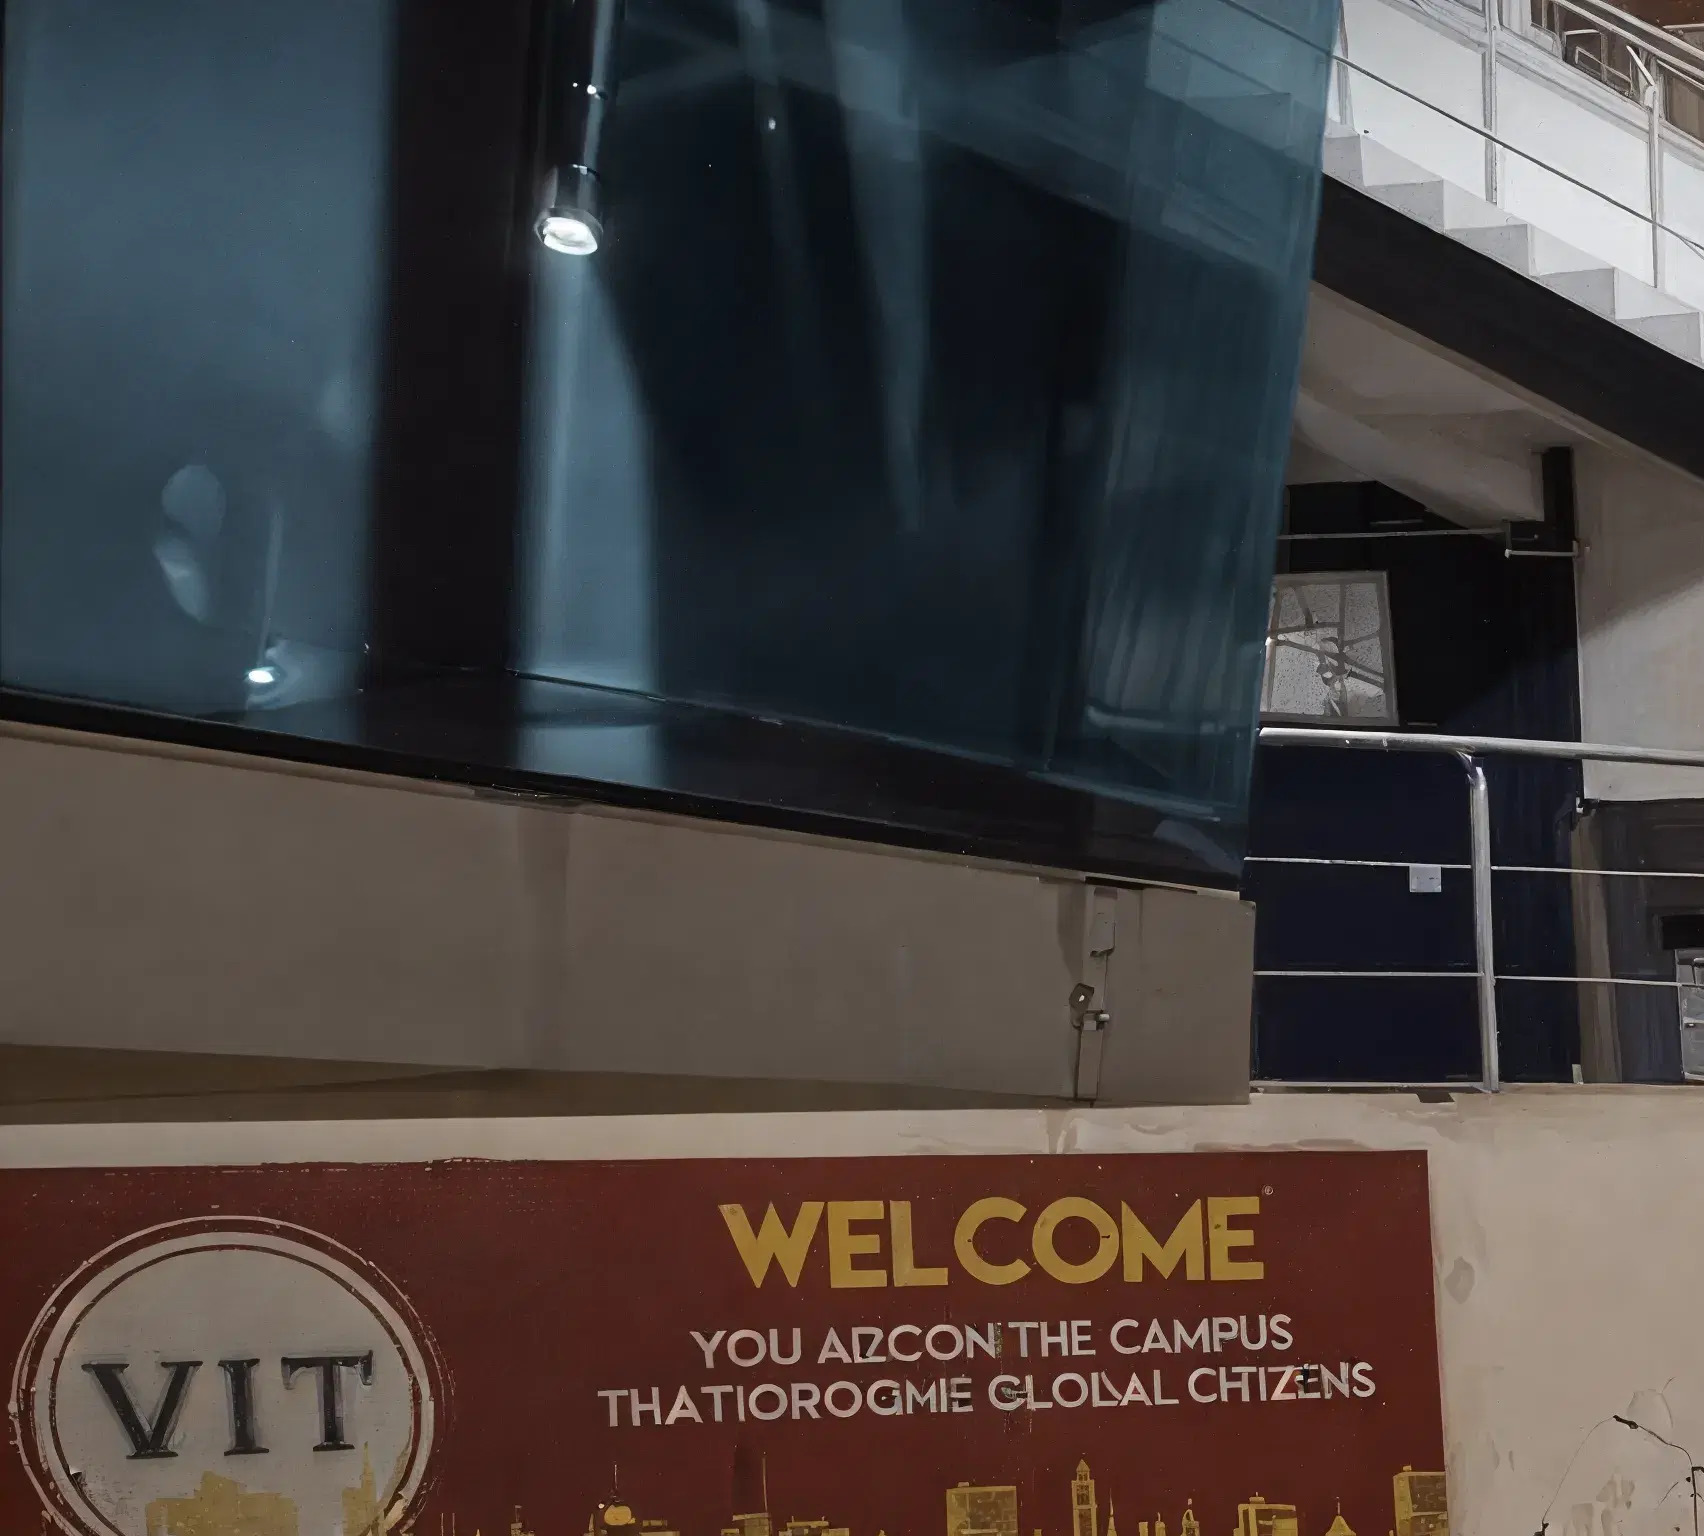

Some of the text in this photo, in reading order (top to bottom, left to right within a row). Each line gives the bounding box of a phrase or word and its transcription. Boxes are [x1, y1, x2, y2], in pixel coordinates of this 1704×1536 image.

[718, 1196, 1264, 1288] WELCOME
[689, 1328, 801, 1368] YOU
[1008, 1320, 1096, 1357] THE
[1110, 1314, 1293, 1354] CAMPUS
[82, 1350, 374, 1459] VIT
